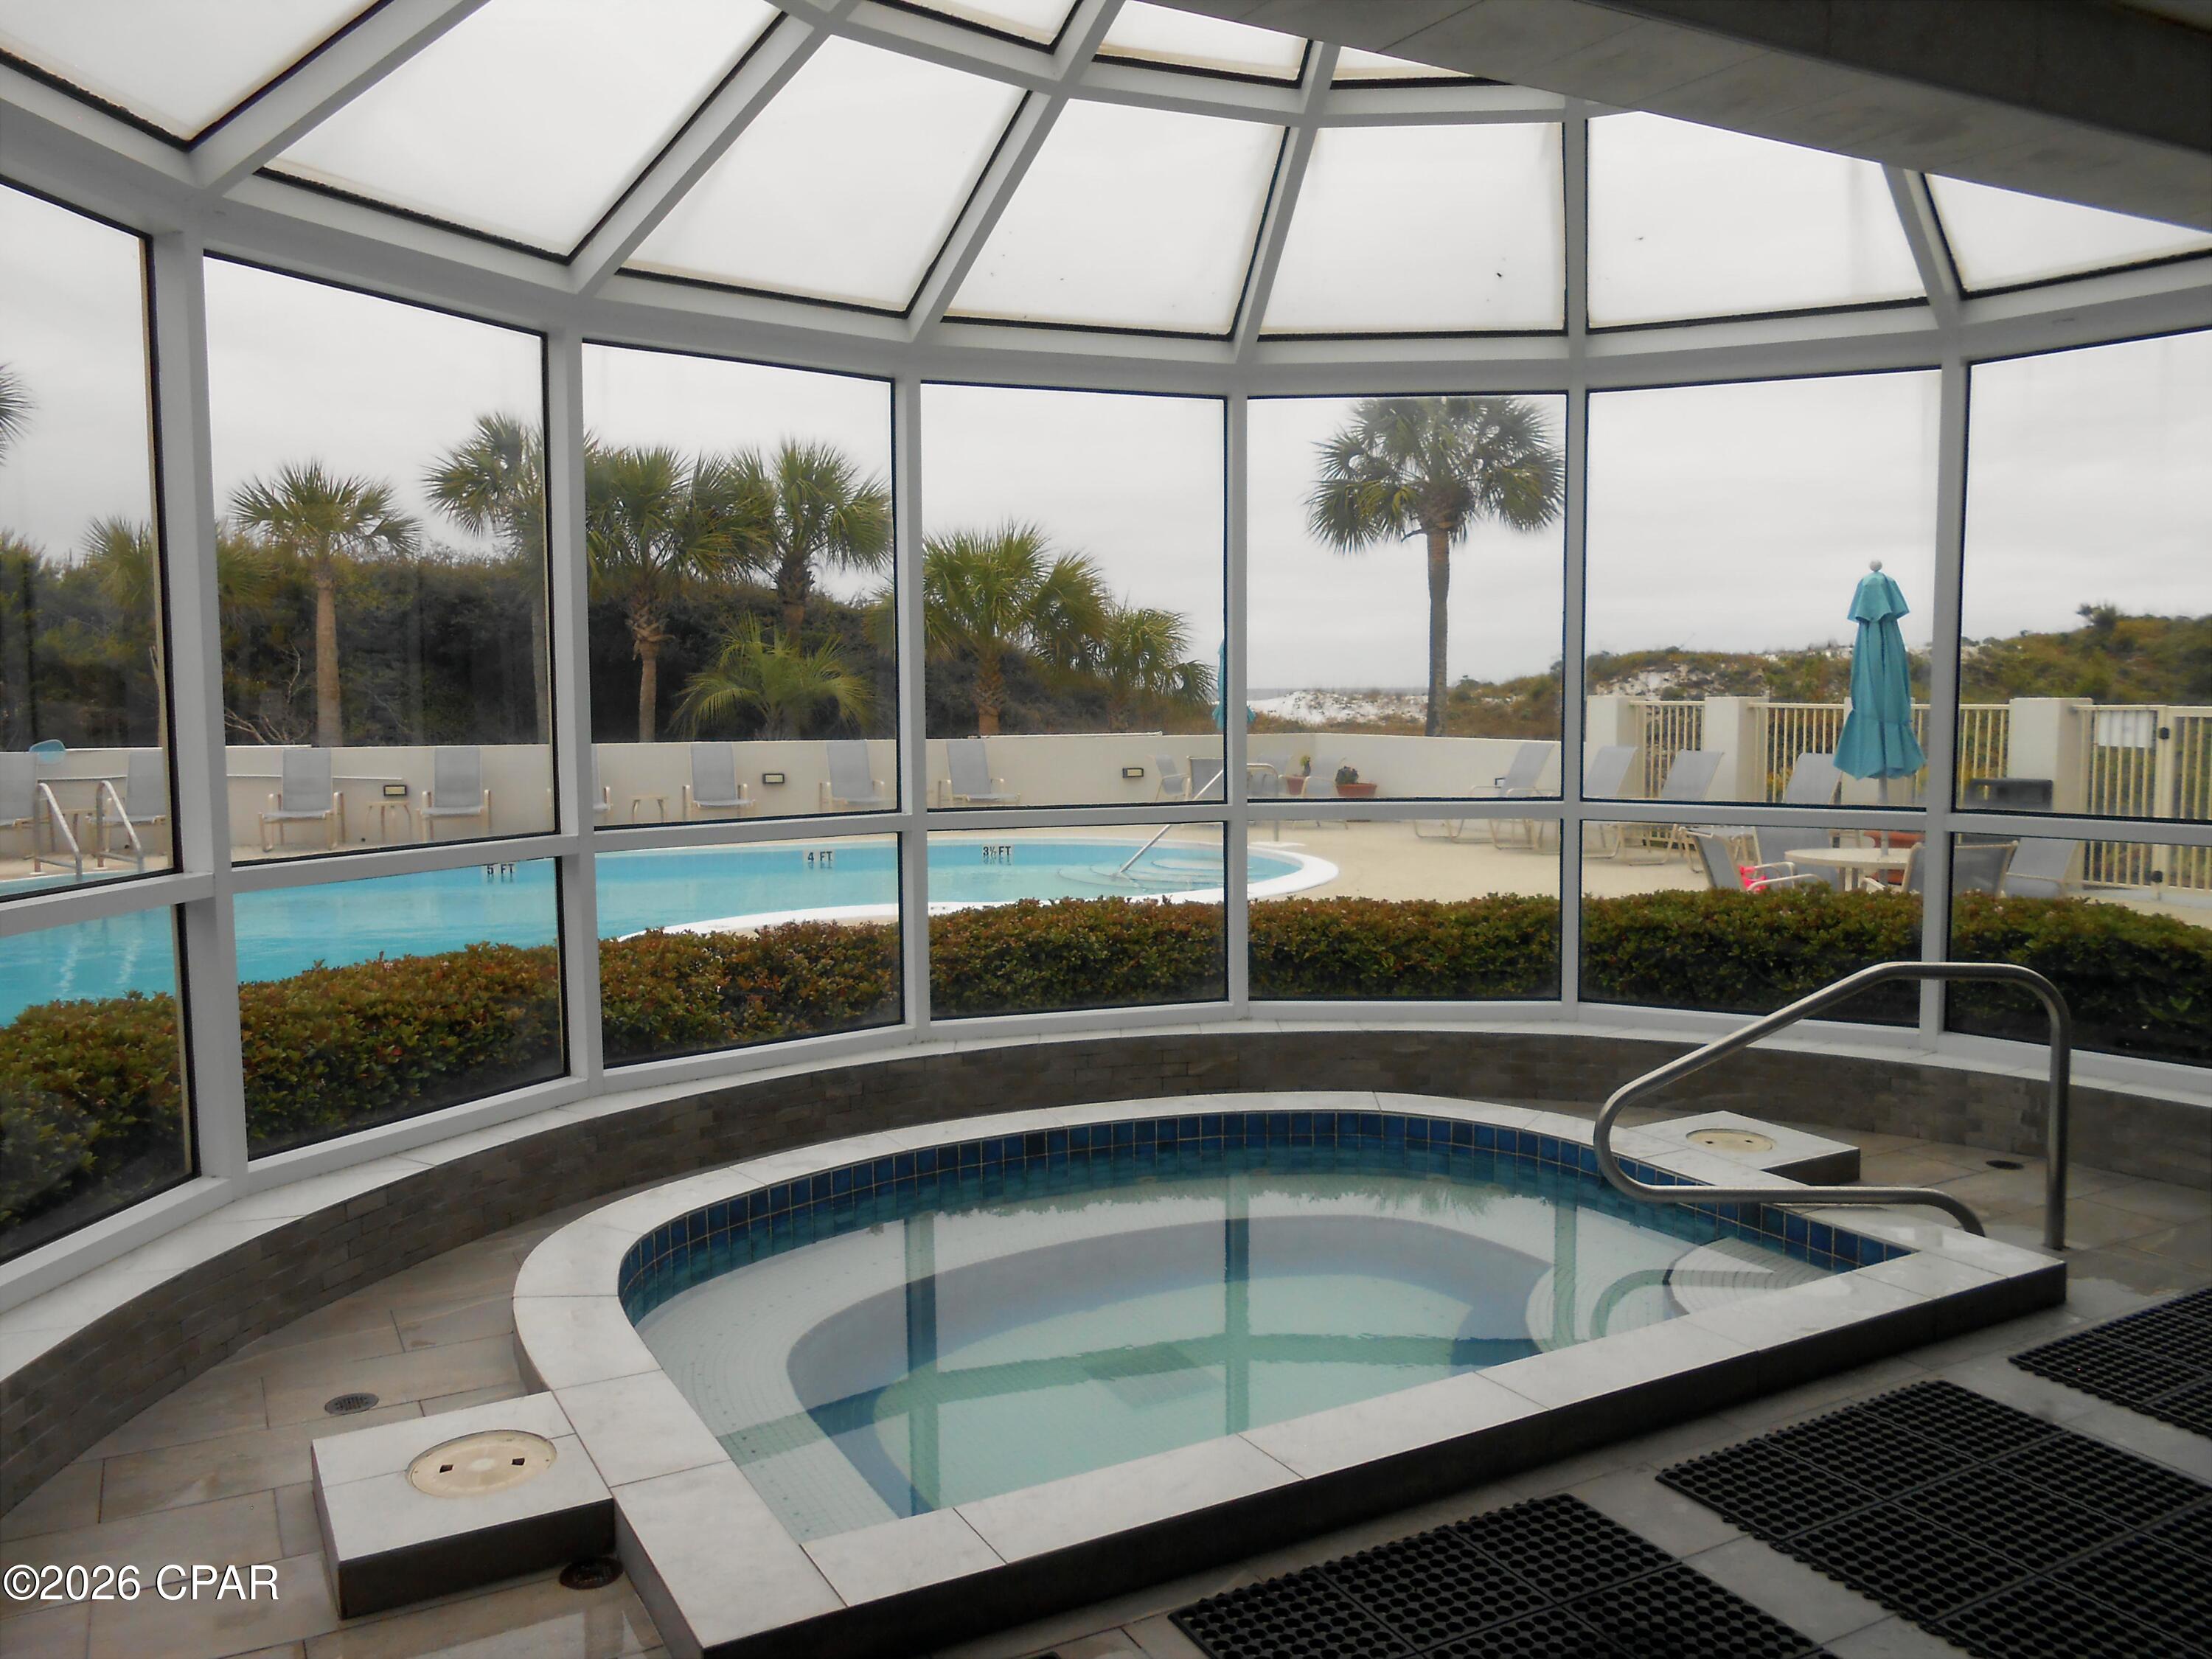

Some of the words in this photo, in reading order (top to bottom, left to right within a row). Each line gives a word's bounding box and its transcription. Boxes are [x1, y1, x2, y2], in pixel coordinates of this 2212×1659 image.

[998, 846, 1011, 855] FT
[807, 852, 814, 861] 4
[820, 851, 832, 861] FT
[487, 864, 494, 874] 5
[501, 863, 514, 874] FT
